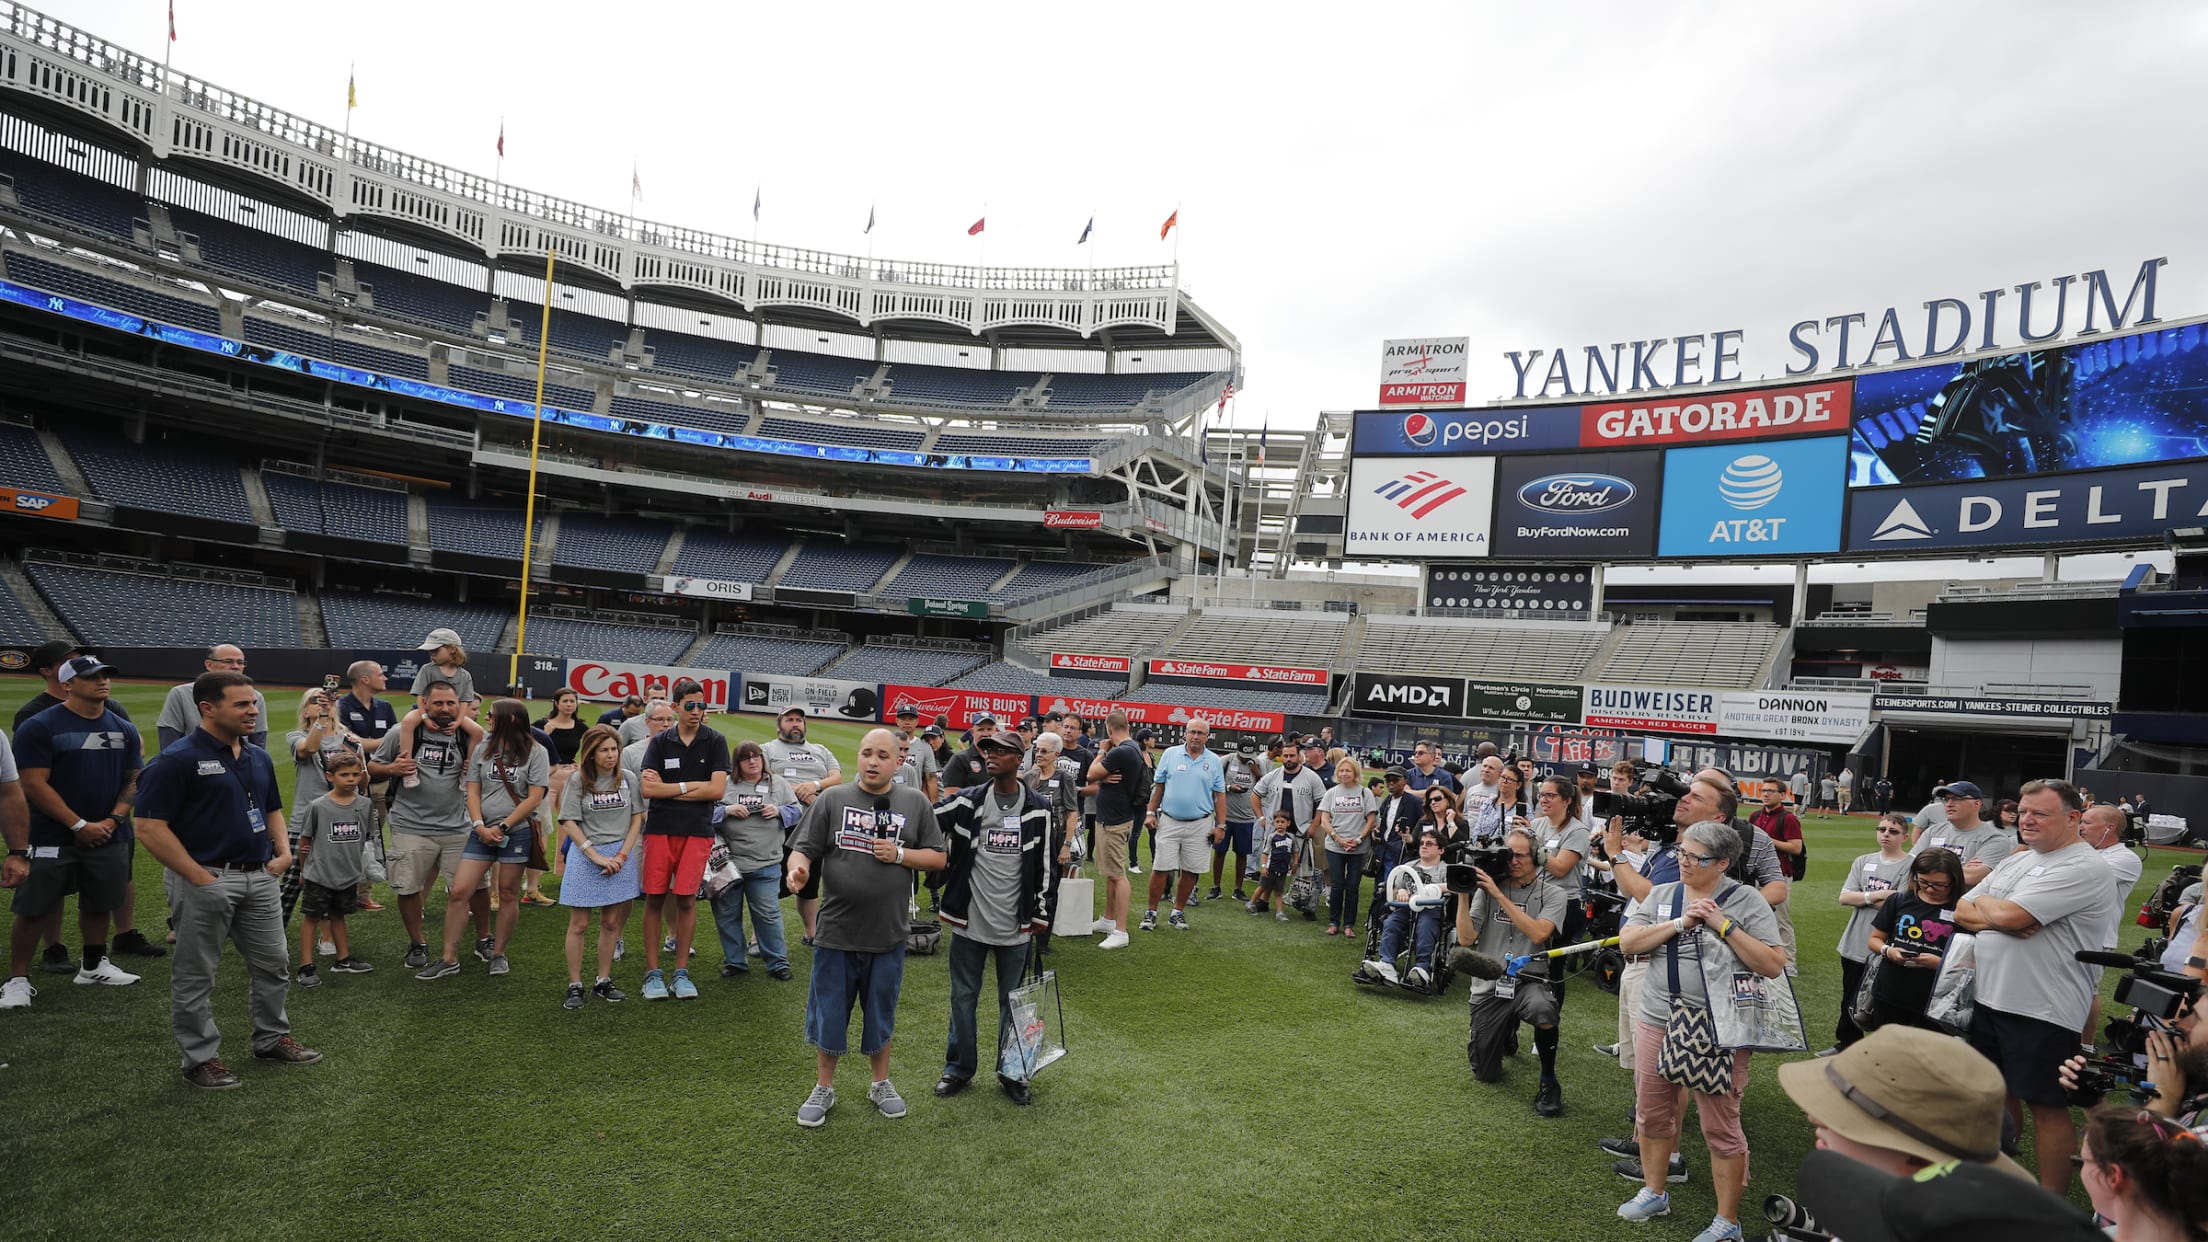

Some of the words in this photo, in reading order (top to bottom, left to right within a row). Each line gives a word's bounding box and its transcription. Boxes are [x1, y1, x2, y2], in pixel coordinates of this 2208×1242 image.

[1504, 328, 1745, 398] YANKEE
[1784, 255, 2169, 376] STADIUM
[1386, 343, 1464, 356] ARMITRON
[1386, 385, 1457, 396] ARMITRON
[1596, 391, 1830, 439] GATORADE
[1443, 414, 1528, 446] pepsi
[747, 491, 773, 501] Audi
[775, 494, 808, 504] YANKEES
[1541, 479, 1611, 508] Ford
[16, 495, 49, 510] SAP
[1045, 513, 1100, 529] Budweiser
[1350, 531, 1391, 543] BANK
[1394, 531, 1413, 543] OF
[1416, 531, 1485, 543] AMERICA
[1517, 525, 1629, 538] BuyFordNow.com
[1708, 518, 1786, 543] AT&T
[707, 581, 742, 594] ORIS
[1473, 584, 1491, 594] New
[1490, 584, 1509, 597] York
[1509, 585, 1541, 598] Yankees
[924, 599, 946, 610] Poland
[946, 600, 968, 612] Spring
[534, 661, 552, 671] 318
[772, 688, 790, 696] NEW
[805, 688, 837, 697] ON-FIELD
[1367, 682, 1427, 706] AMD
[1473, 684, 1509, 692] Workmen's
[771, 695, 789, 703] ERA
[964, 696, 990, 709] THIS
[993, 698, 1027, 713] BUD'S
[1590, 689, 1712, 713] BUDWEISER
[1759, 697, 1828, 712] DANNON
[1875, 698, 1957, 709] STEINERSPORTS.COM
[1964, 701, 2041, 713] YANKEES-STEINER
[2044, 704, 2109, 715] COLLECTIBLES
[1502, 709, 1526, 717] Matters
[1550, 711, 1567, 720] You!
[1590, 709, 1653, 718] DISCOVERY
[1724, 712, 1762, 722] ANOTHER
[1764, 714, 1789, 723] GREAT
[1791, 715, 1819, 725] BRONX
[1821, 716, 1863, 727] DYNASTY
[1594, 717, 1646, 726] AMERICAN
[1648, 720, 1668, 728] RED
[1672, 721, 1706, 730] LAGER
[1775, 728, 1787, 736] EST
[1789, 728, 1805, 736] 1942
[594, 793, 619, 801] HOPE
[739, 796, 762, 804] HOPE
[989, 834, 1017, 843] HOPE
[1868, 880, 1890, 890] HOPE
